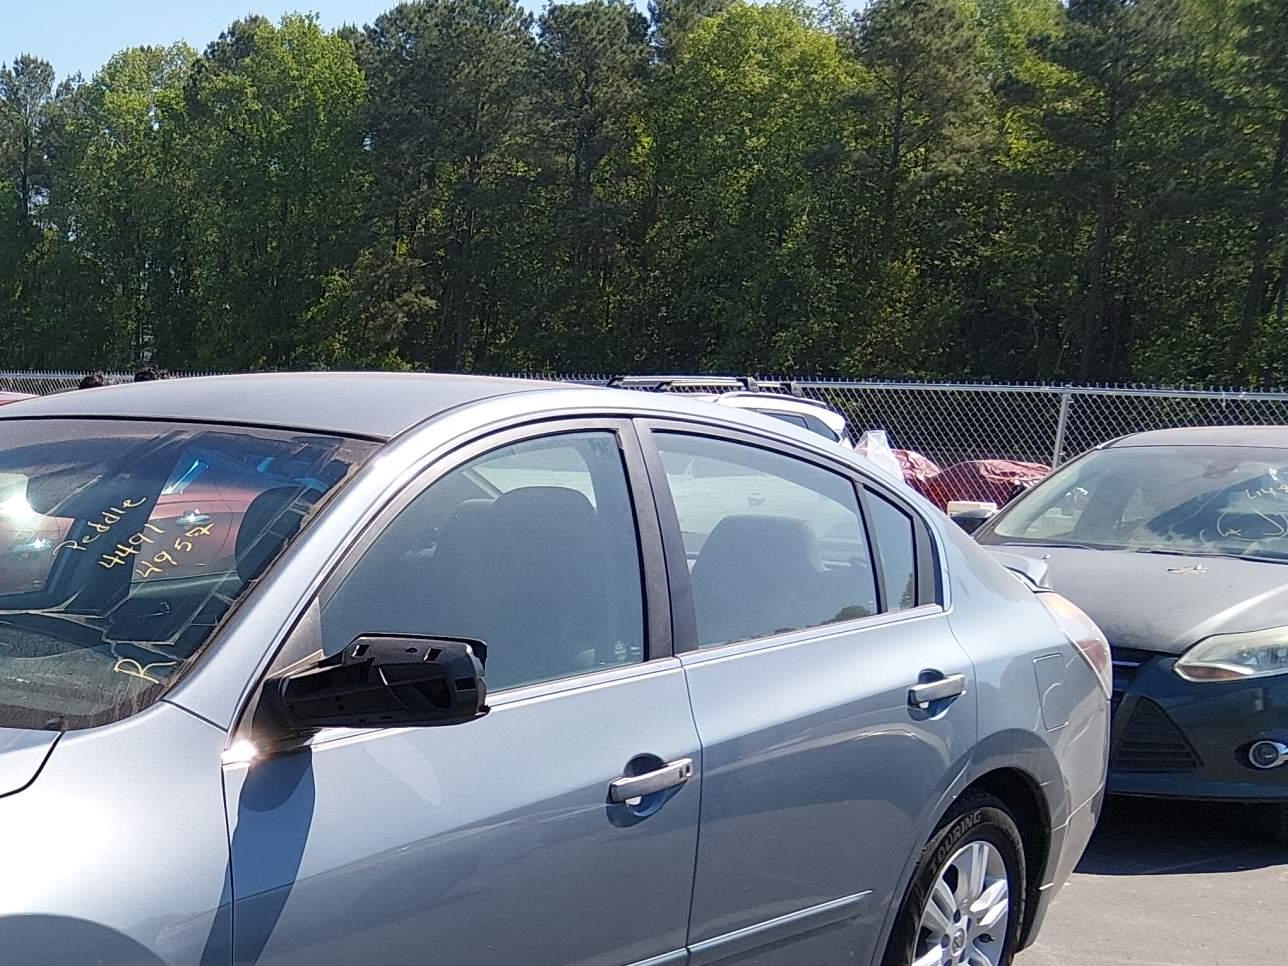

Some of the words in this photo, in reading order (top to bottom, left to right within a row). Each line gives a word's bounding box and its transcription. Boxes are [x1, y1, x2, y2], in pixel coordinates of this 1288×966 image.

[98, 523, 165, 569] 4491
[114, 659, 177, 684] R
[928, 809, 982, 874] TOURING
